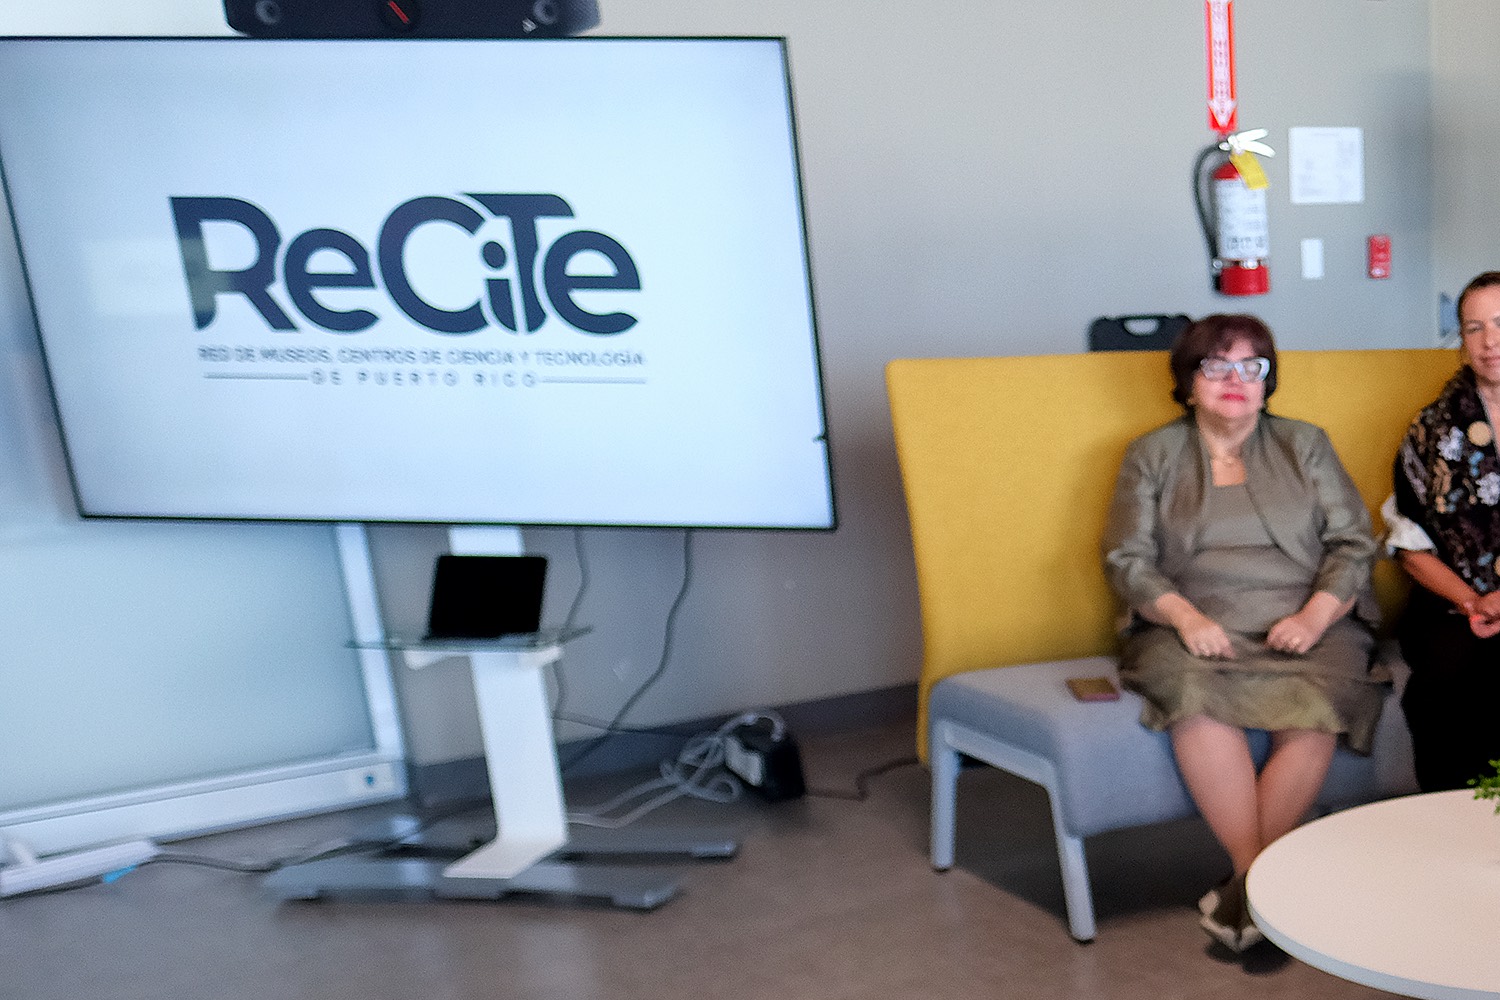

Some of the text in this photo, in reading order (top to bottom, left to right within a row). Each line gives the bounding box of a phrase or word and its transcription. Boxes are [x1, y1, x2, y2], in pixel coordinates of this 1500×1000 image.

[169, 193, 642, 336] ReCiTe
[198, 345, 231, 362] RED
[235, 346, 256, 362] DE
[337, 347, 416, 364] CENTROS
[419, 348, 441, 364] DE
[446, 348, 515, 365] CIENCIA
[310, 368, 537, 387] DE PUERTO RICO
